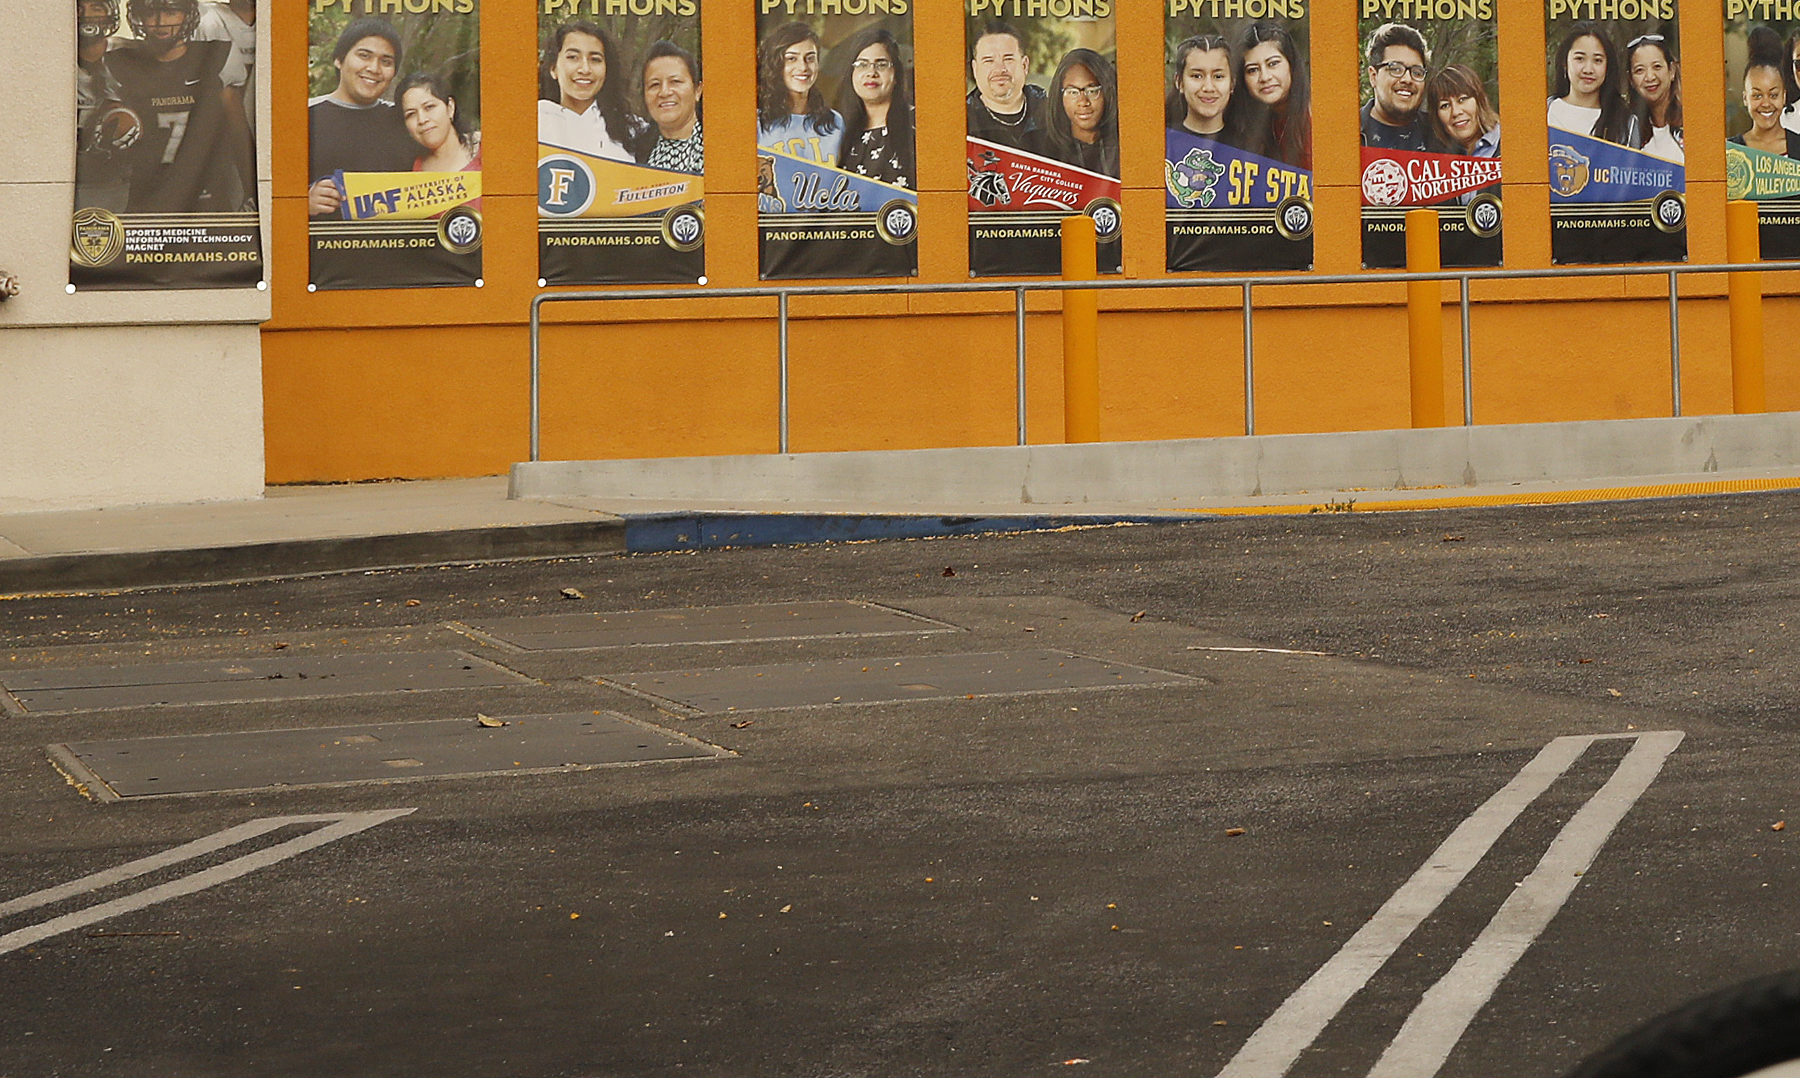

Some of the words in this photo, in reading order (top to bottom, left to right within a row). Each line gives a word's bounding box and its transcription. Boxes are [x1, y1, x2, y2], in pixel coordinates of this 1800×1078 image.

[157, 111, 191, 163] 7
[1011, 162, 1031, 171] SANTA
[1032, 167, 1062, 178] BARBARA
[1756, 155, 1772, 173] LOS
[1407, 159, 1447, 184] CAL
[404, 178, 450, 192] UNIVERSITY
[545, 168, 575, 205] F
[1040, 175, 1054, 183] CITY
[1056, 179, 1083, 190] COLLEGE
[1227, 159, 1259, 205] SF
[1266, 167, 1312, 203] STA
[1756, 177, 1784, 195] VALLEY
[406, 183, 466, 202] ALASKA
[618, 183, 685, 203] FULLERTON
[1008, 172, 1079, 208] Vaqueros
[407, 192, 468, 209] FAIRBANKS
[1173, 226, 1273, 235] PANORAMAHS.ORG
[1368, 223, 1465, 232] PANOR.ORG
[1557, 219, 1650, 229] PANORAMAHS.ORG
[125, 229, 161, 237] SPORTS
[163, 228, 206, 236] MEDICINE
[125, 236, 189, 244] INFORMATION
[192, 235, 253, 243] TECHNOLOGY
[765, 230, 875, 241] PANORAMAHS.ORG
[976, 229, 1062, 238] PANORAMAHS.
[125, 243, 164, 251] MAGNET
[316, 238, 436, 250] PANORAMAHS.ORG
[546, 235, 660, 247] PANORAMAHS.ORG
[125, 251, 257, 263] PANORAMAHS.ORG
